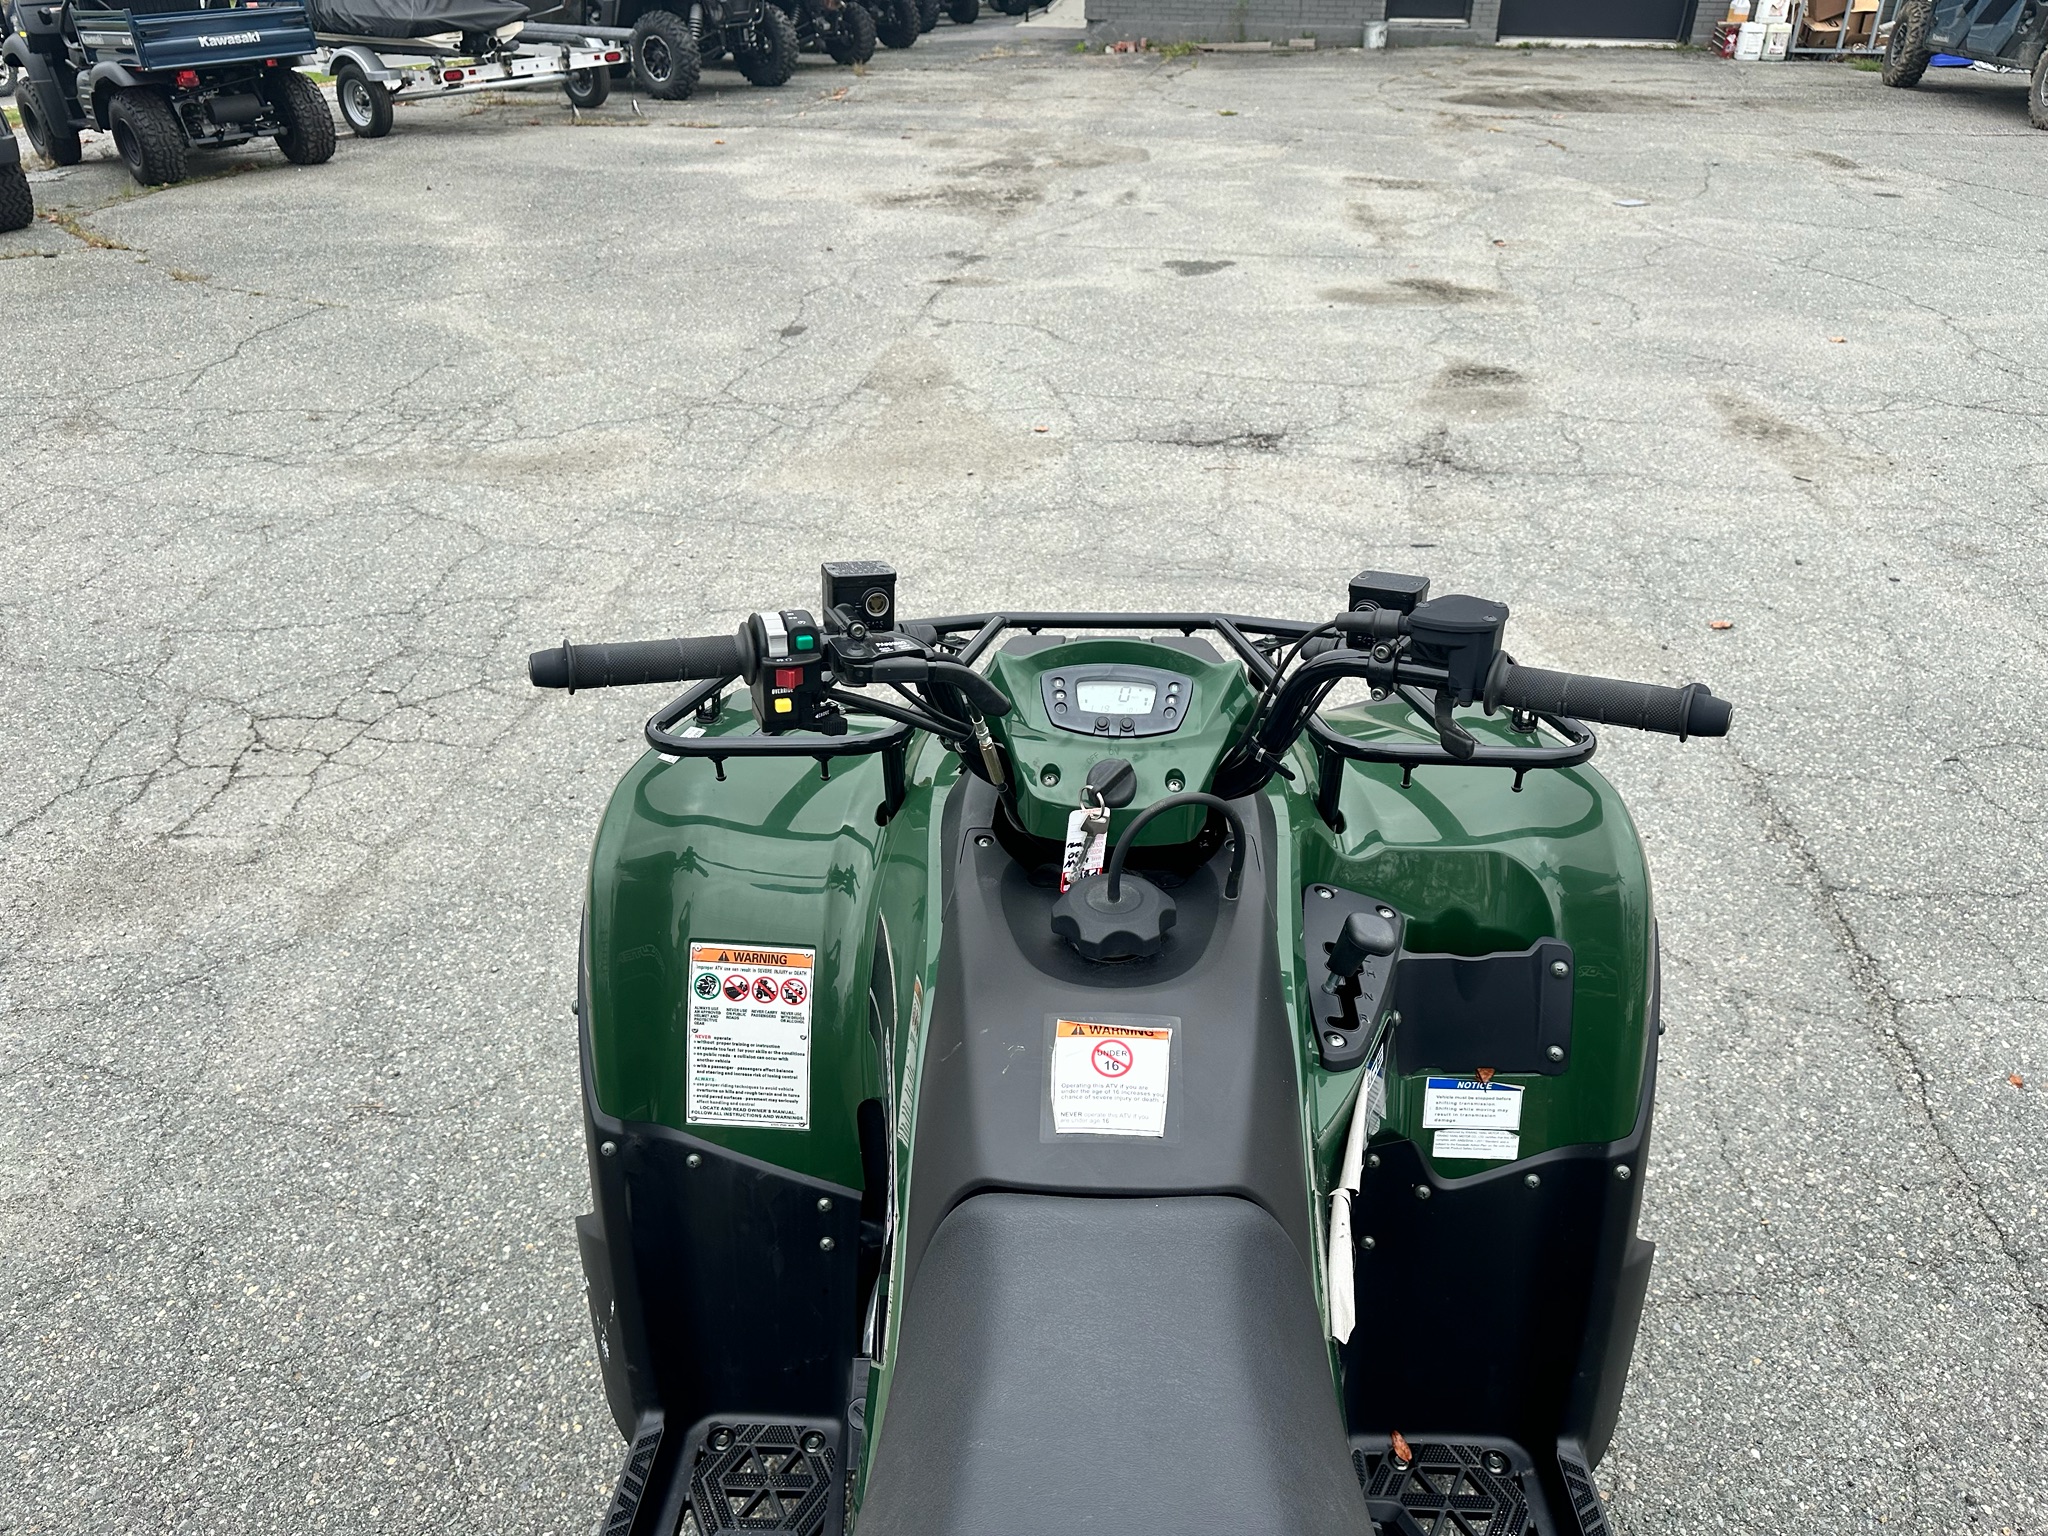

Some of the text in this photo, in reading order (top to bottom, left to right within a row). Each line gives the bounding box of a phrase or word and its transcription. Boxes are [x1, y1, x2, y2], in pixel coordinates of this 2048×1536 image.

[198, 32, 260, 47] Kawasaki
[734, 952, 787, 964] WARNING
[1364, 992, 1373, 1001] N
[1089, 1026, 1154, 1036] WARNING
[1105, 1060, 1119, 1071] 16
[1457, 1082, 1492, 1090] NOTICE
